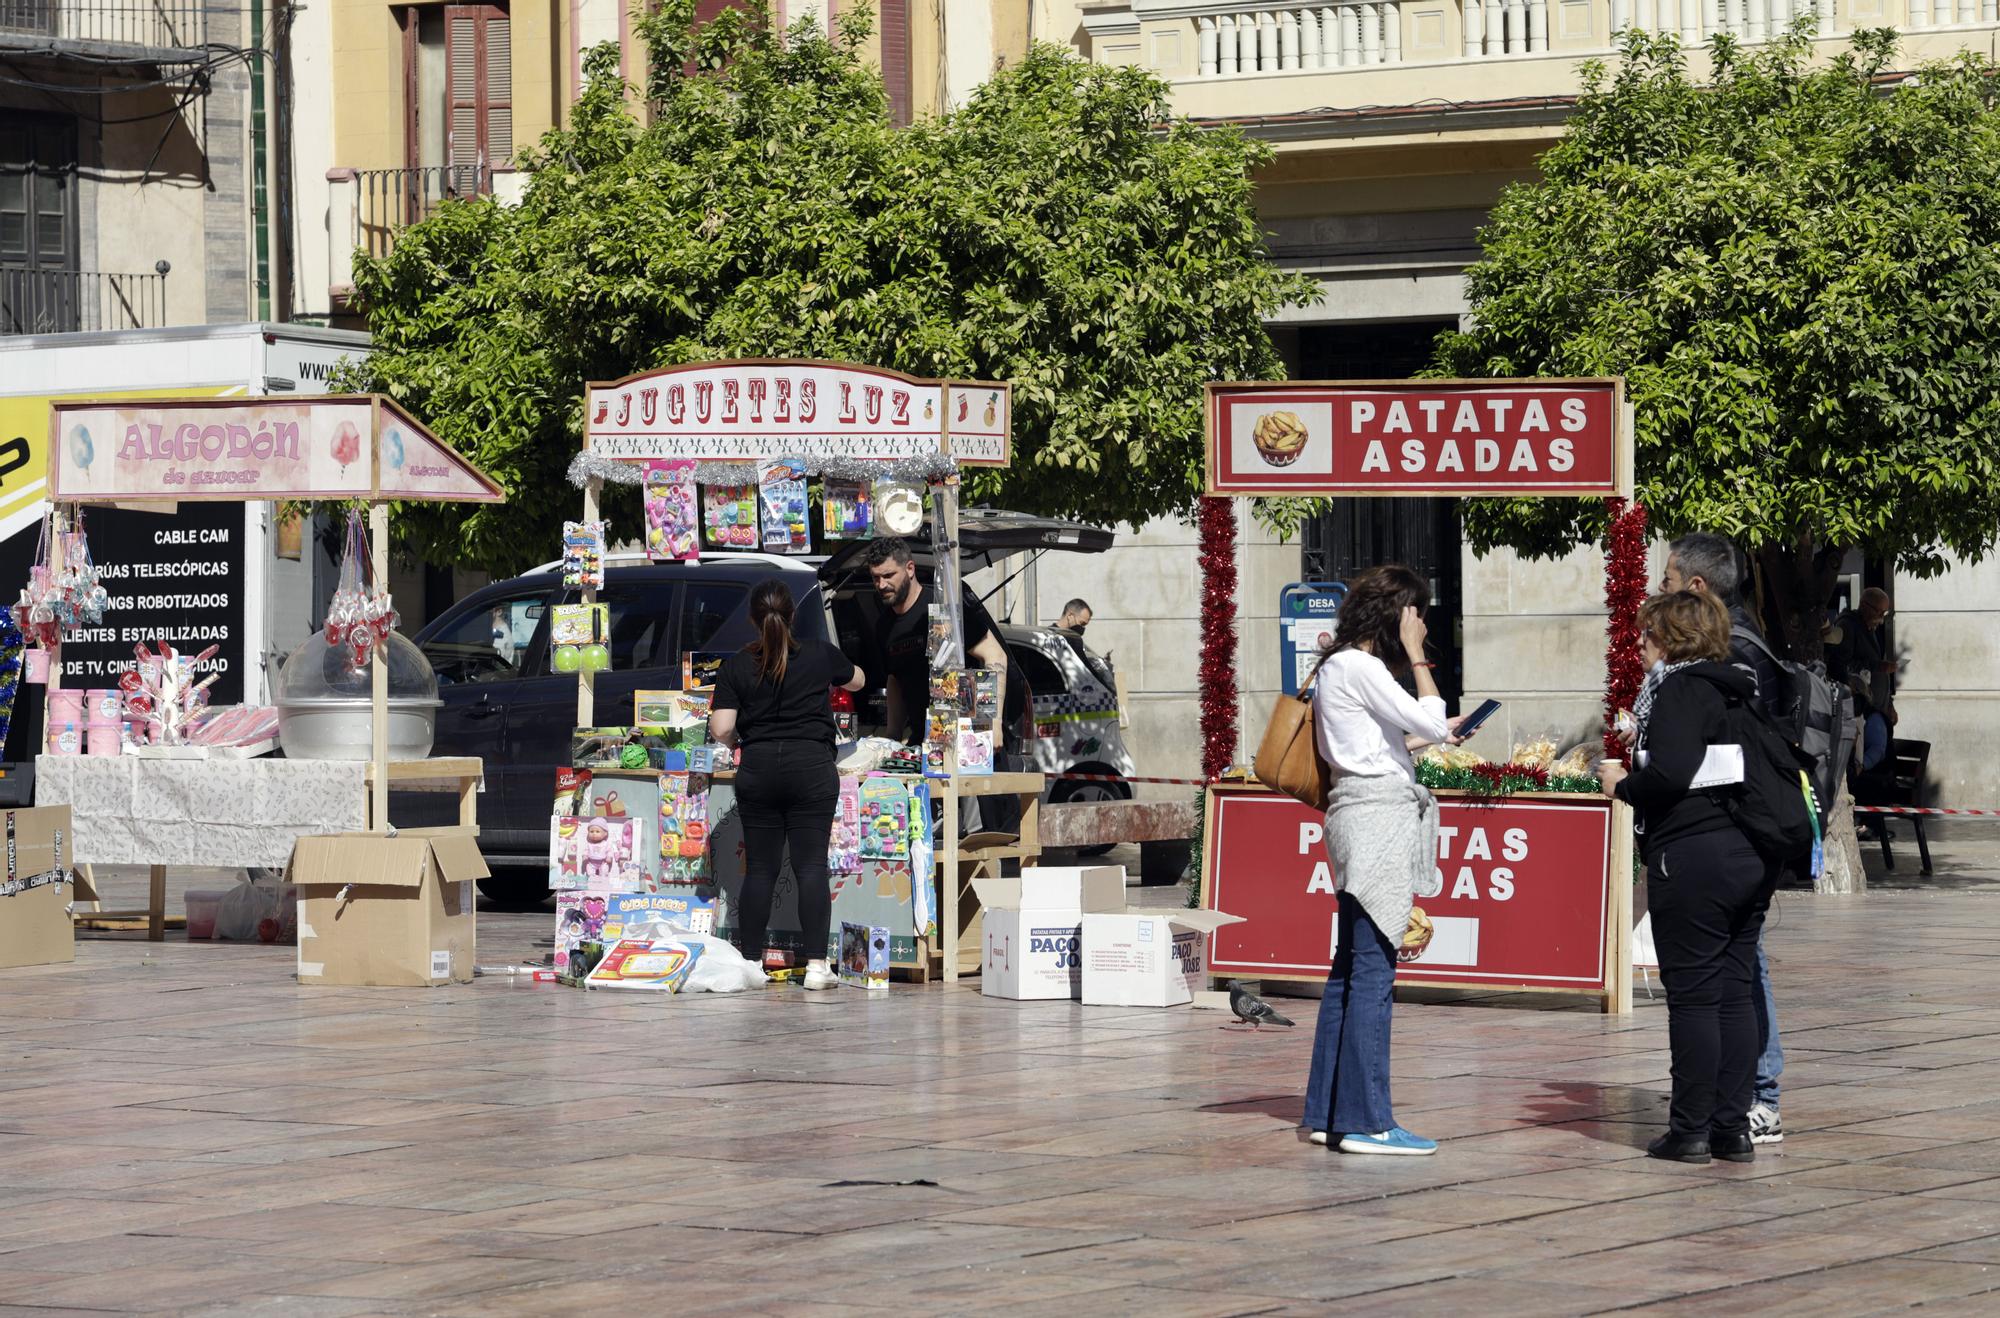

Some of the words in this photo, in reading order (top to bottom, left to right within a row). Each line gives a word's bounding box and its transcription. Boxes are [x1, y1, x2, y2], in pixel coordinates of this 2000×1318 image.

[615, 378, 816, 426] JUGUETES
[838, 380, 910, 425] LUZ
[1351, 398, 1588, 434] PATATAS
[1360, 438, 1575, 473] ASADAS
[163, 468, 186, 485] de
[154, 530, 197, 544] CABLE
[200, 529, 229, 543] CAM
[133, 559, 229, 578] TELESCÓPICAS
[138, 594, 229, 609] ROBOTIZADOS
[1308, 599, 1335, 608] DESA
[122, 626, 229, 642] ESTABILIZADAS
[67, 661, 83, 674] DE
[87, 660, 104, 676] TV,
[1299, 822, 1528, 862] PTAS
[1306, 861, 1515, 901] AAS
[1030, 938, 1080, 952] PACO
[1172, 943, 1192, 959] PACO
[1055, 953, 1082, 968] JO
